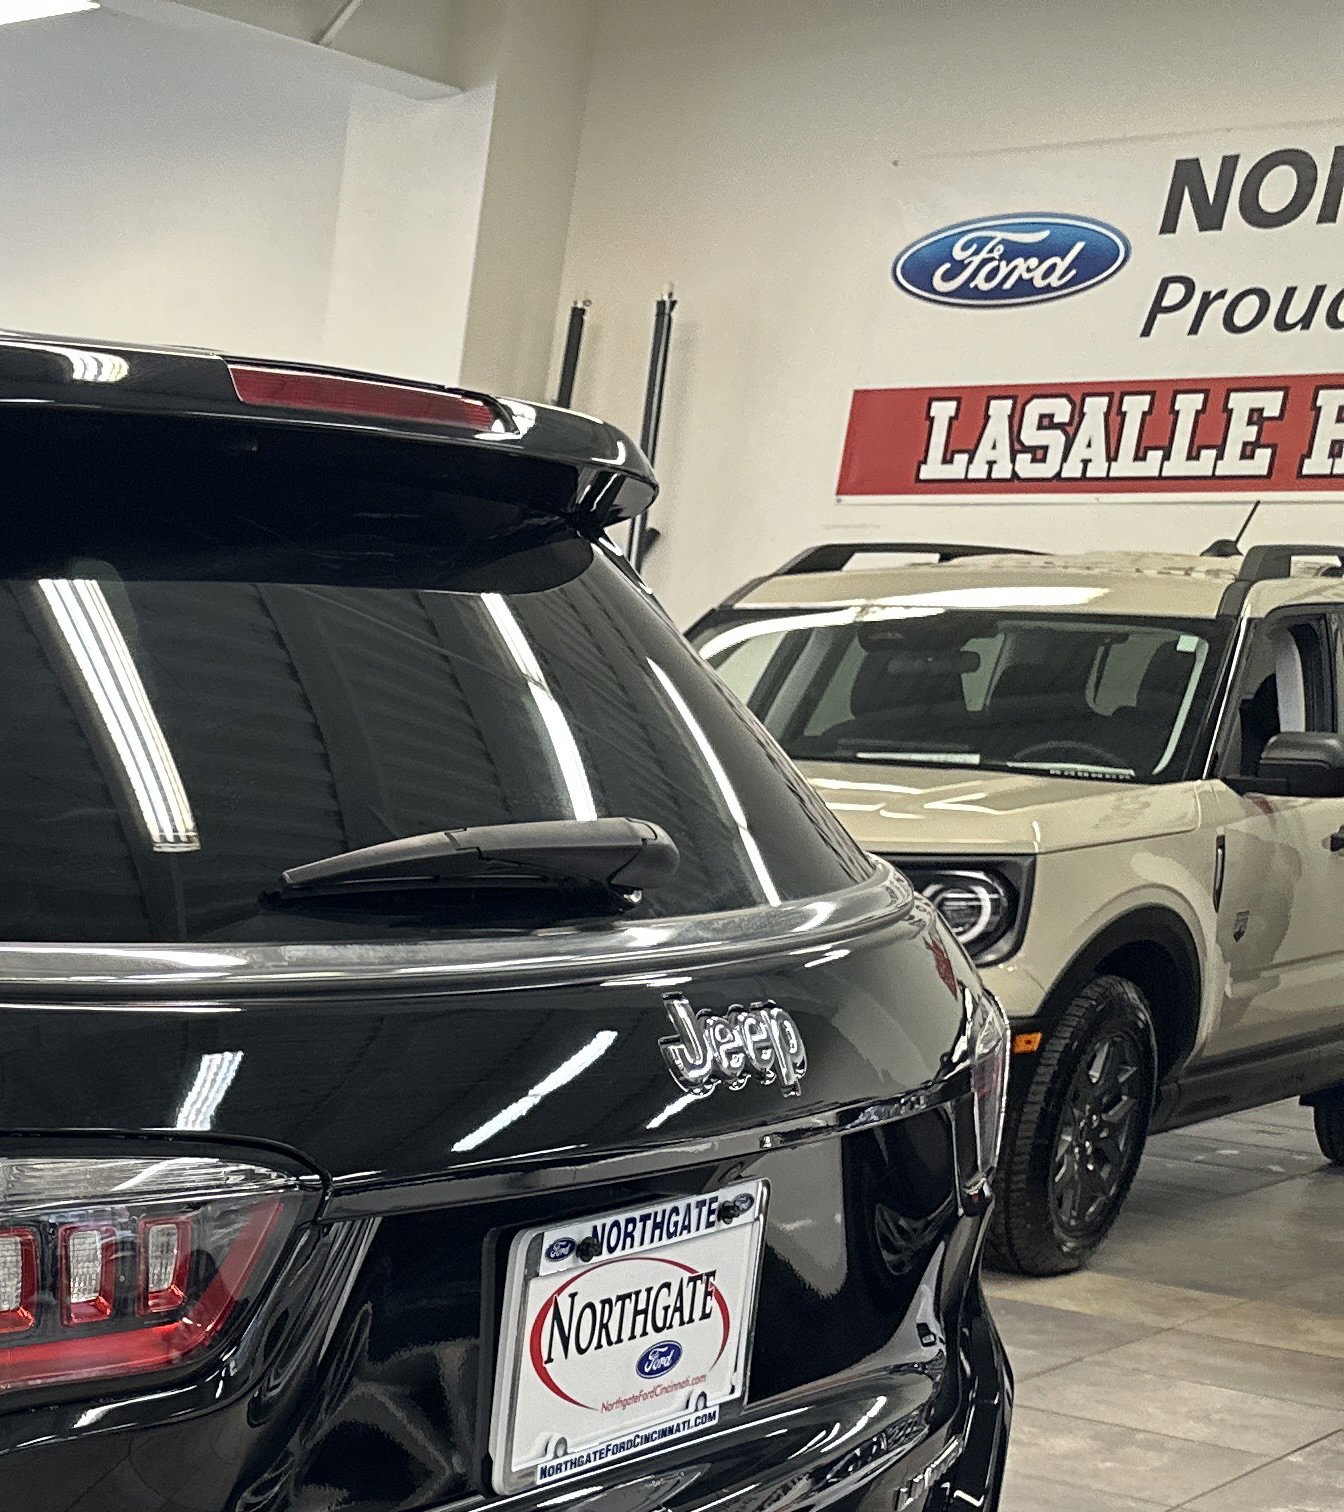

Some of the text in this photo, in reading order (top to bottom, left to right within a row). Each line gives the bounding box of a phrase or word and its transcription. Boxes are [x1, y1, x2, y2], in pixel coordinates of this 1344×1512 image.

[932, 229, 1086, 293] Ford
[916, 386, 1289, 483] LASALLE
[658, 990, 808, 1098] Jeep
[591, 1195, 719, 1255] NORTHGATE
[646, 1350, 674, 1372] Ford
